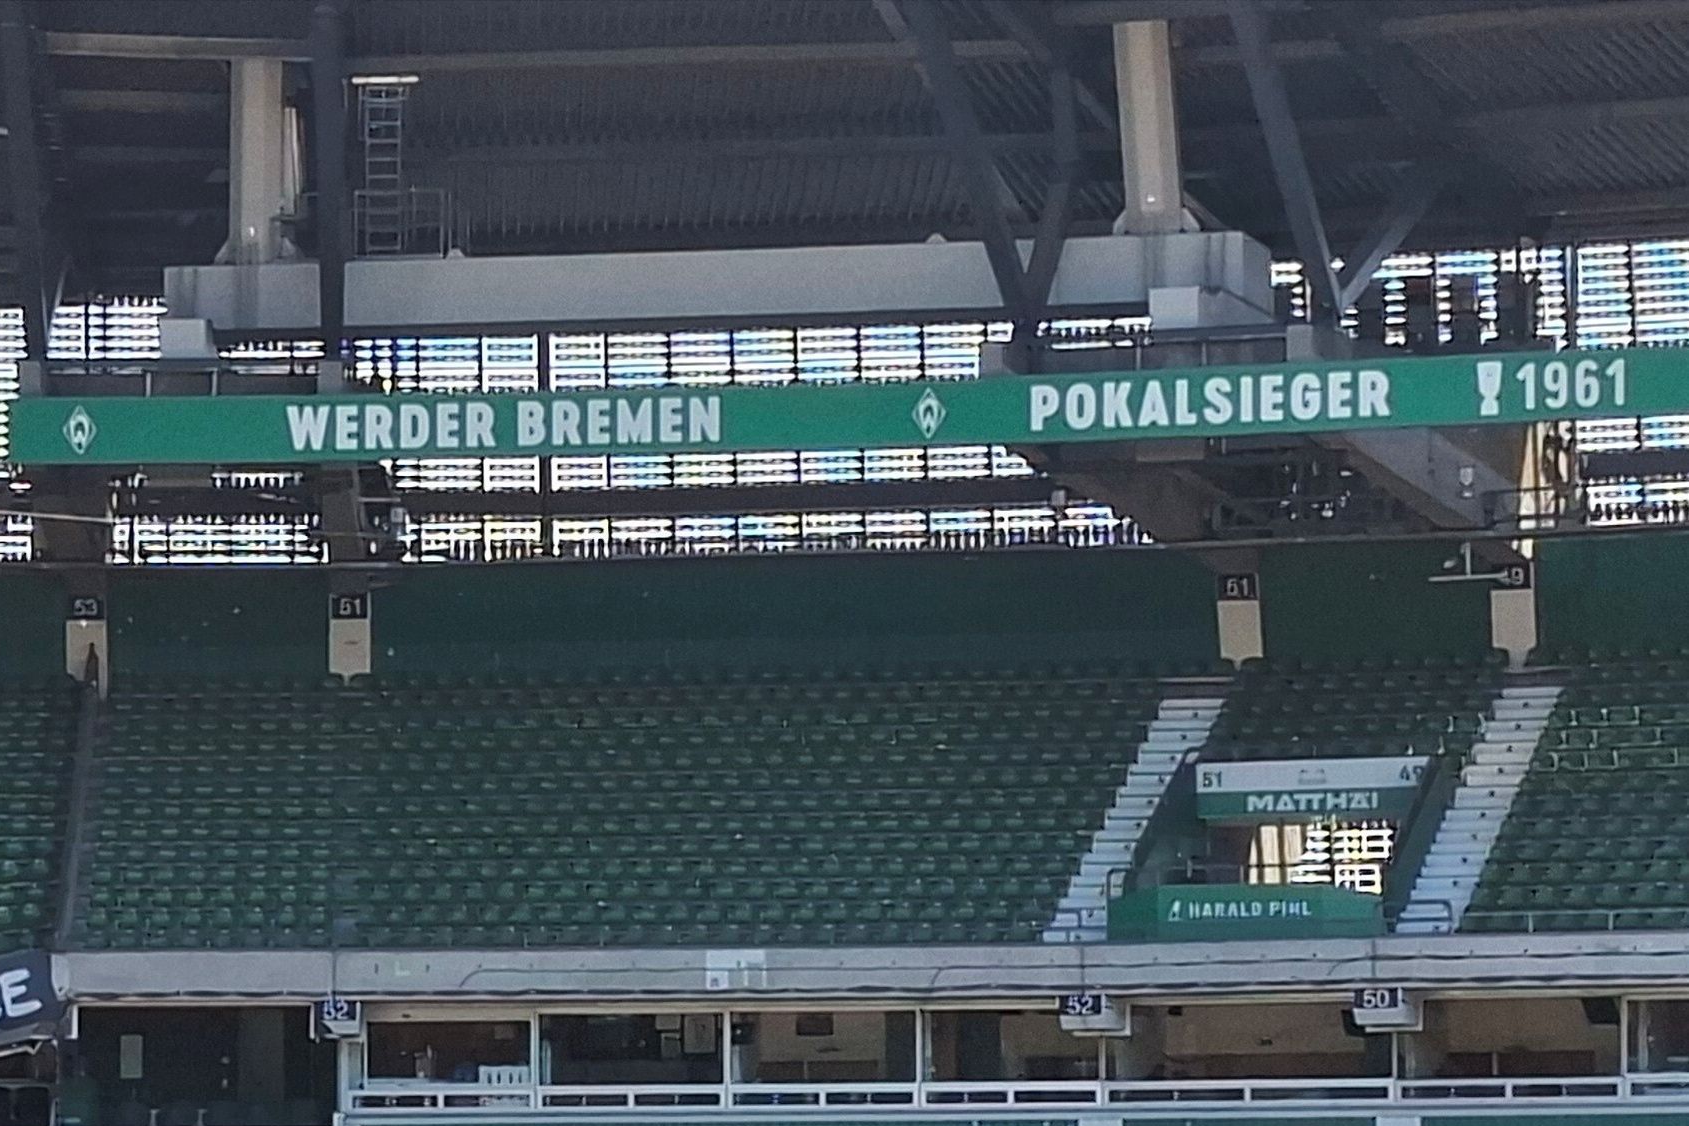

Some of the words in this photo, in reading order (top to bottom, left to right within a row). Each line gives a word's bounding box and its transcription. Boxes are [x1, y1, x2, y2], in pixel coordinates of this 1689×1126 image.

[1029, 371, 1390, 431] POKALSIEGER
[1516, 358, 1626, 410] 1961
[286, 402, 497, 450] WERDER
[517, 396, 721, 447] BREMEN
[1188, 901, 1262, 919] HARALD
[1067, 996, 1093, 1015] 52
[1363, 989, 1390, 1008] 50
